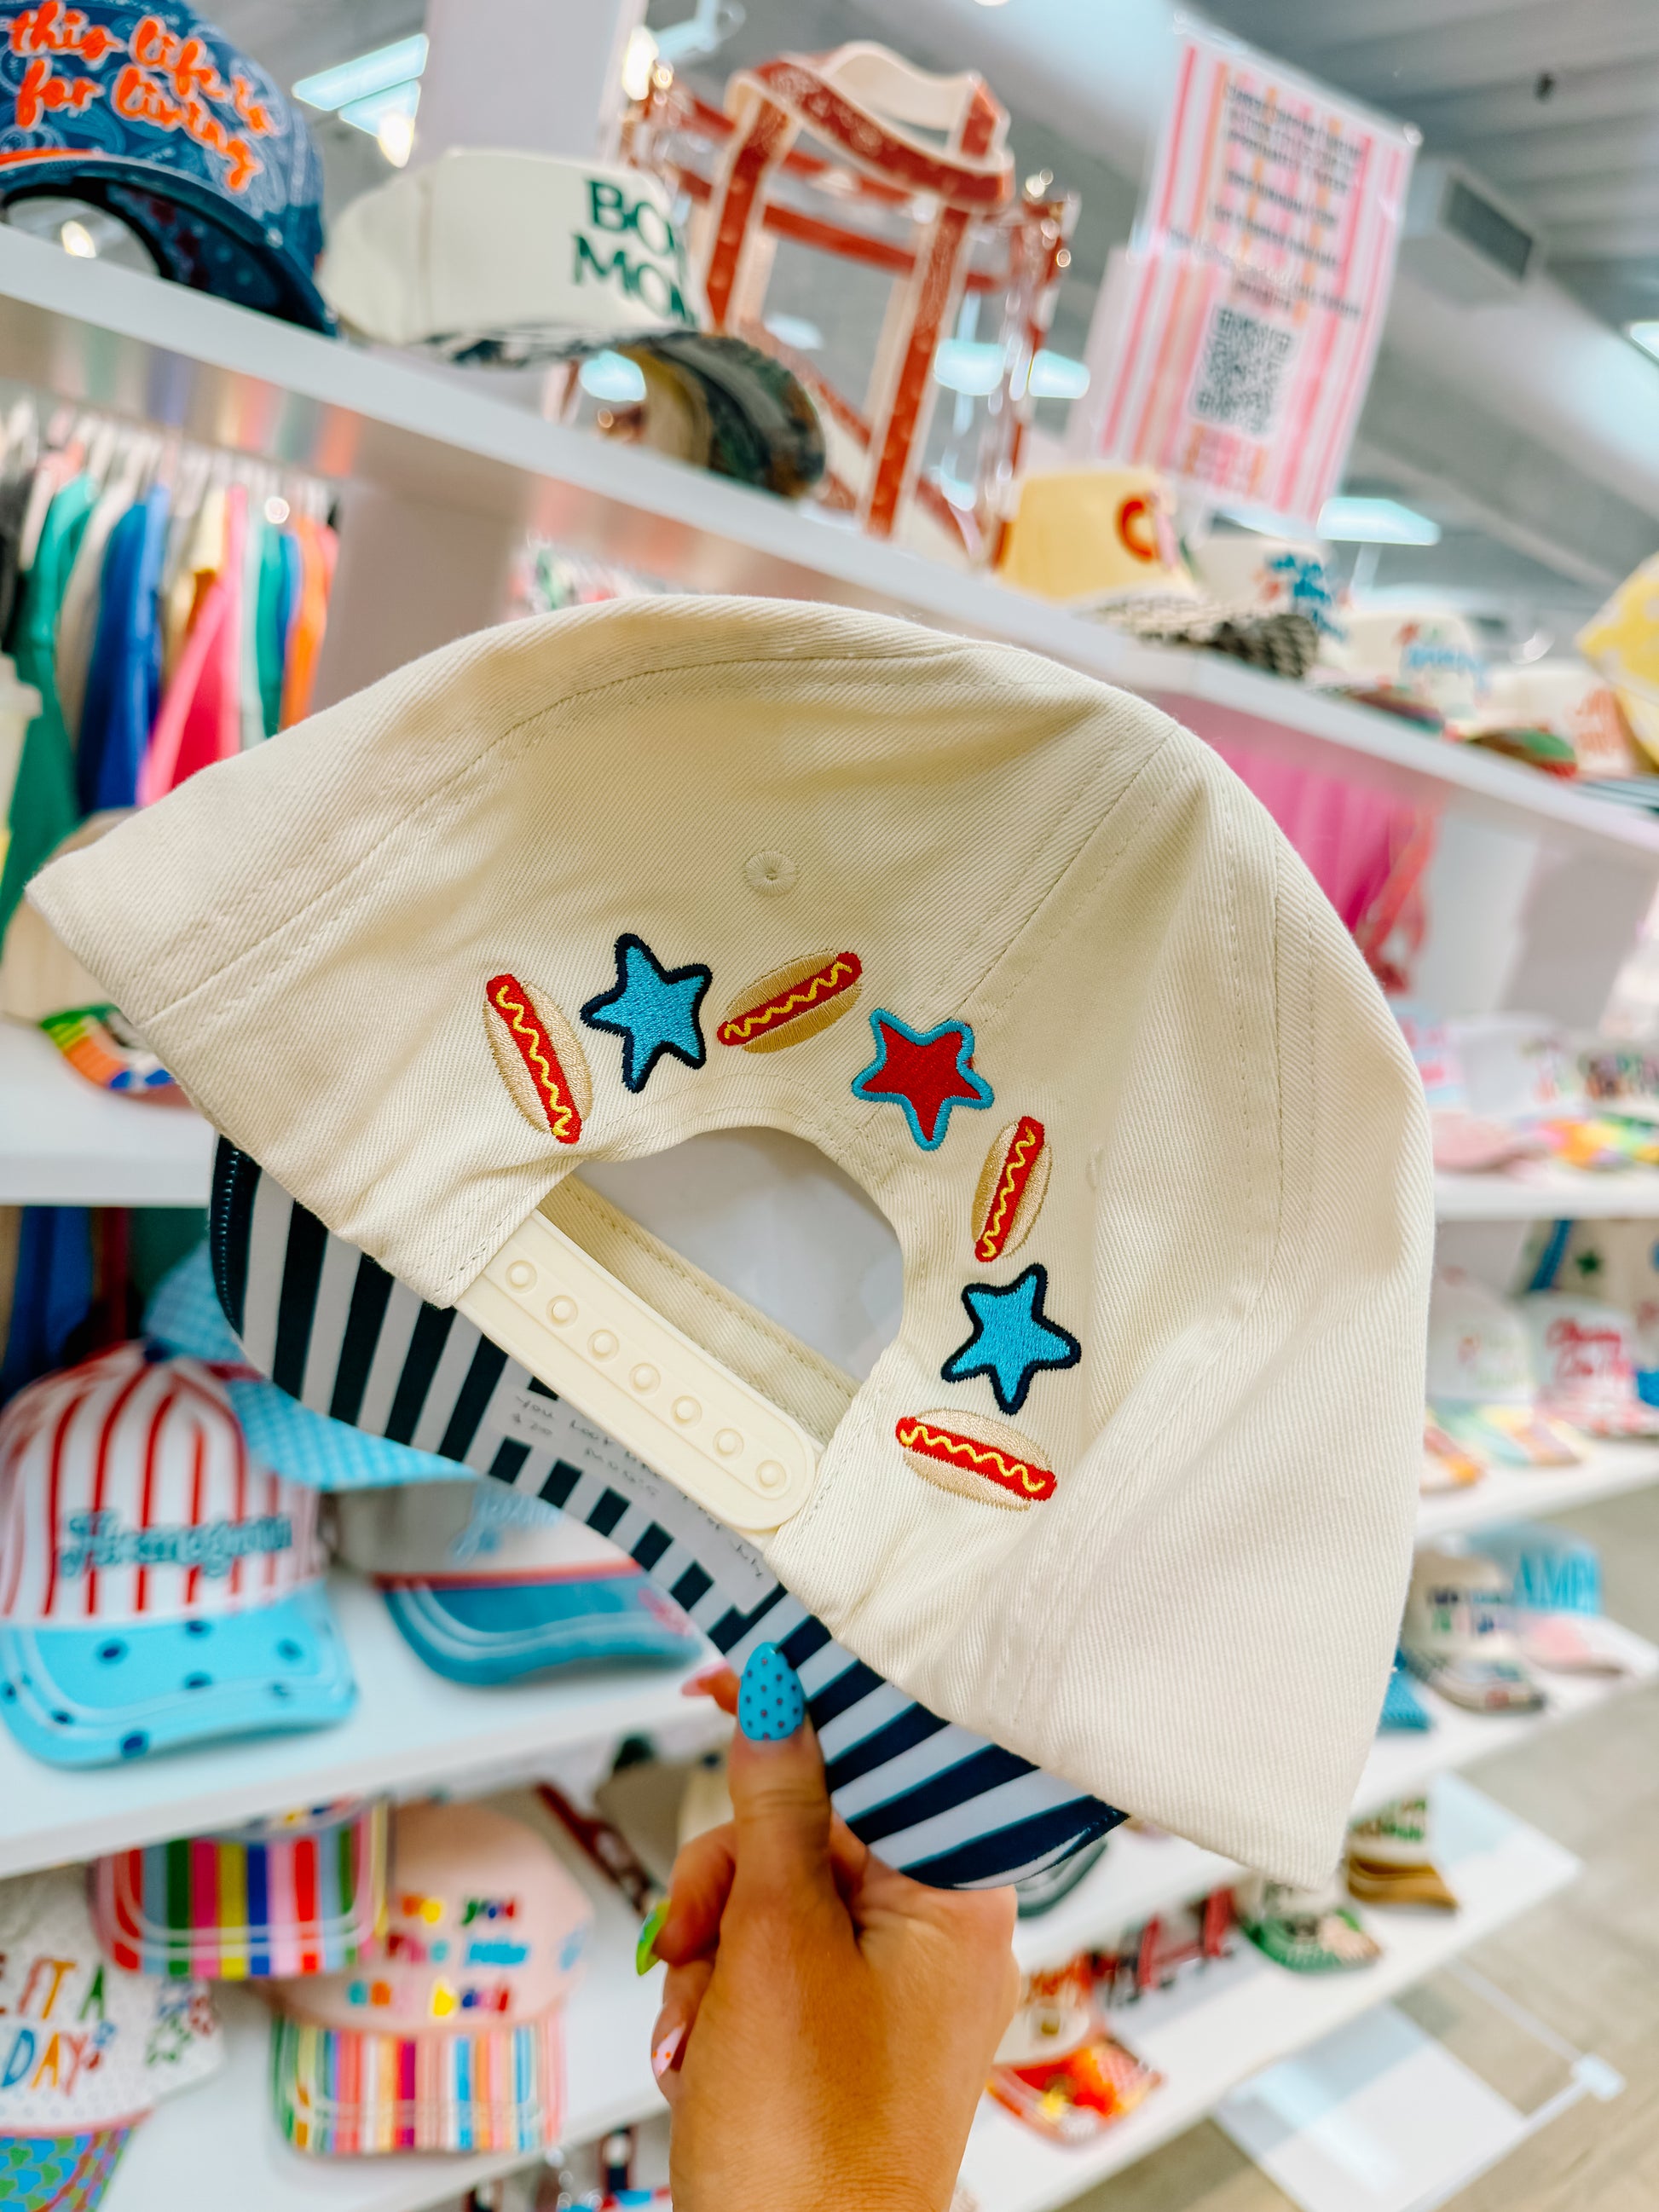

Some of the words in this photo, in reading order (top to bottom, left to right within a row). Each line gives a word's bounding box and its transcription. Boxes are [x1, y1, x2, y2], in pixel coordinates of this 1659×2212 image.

[8, 0, 124, 62] this
[130, 15, 232, 100] life
[15, 57, 104, 130] for
[113, 64, 263, 194] living
[17, 1955, 78, 2021] IT
[78, 1963, 107, 2021] A
[0, 2029, 90, 2097] DAY
